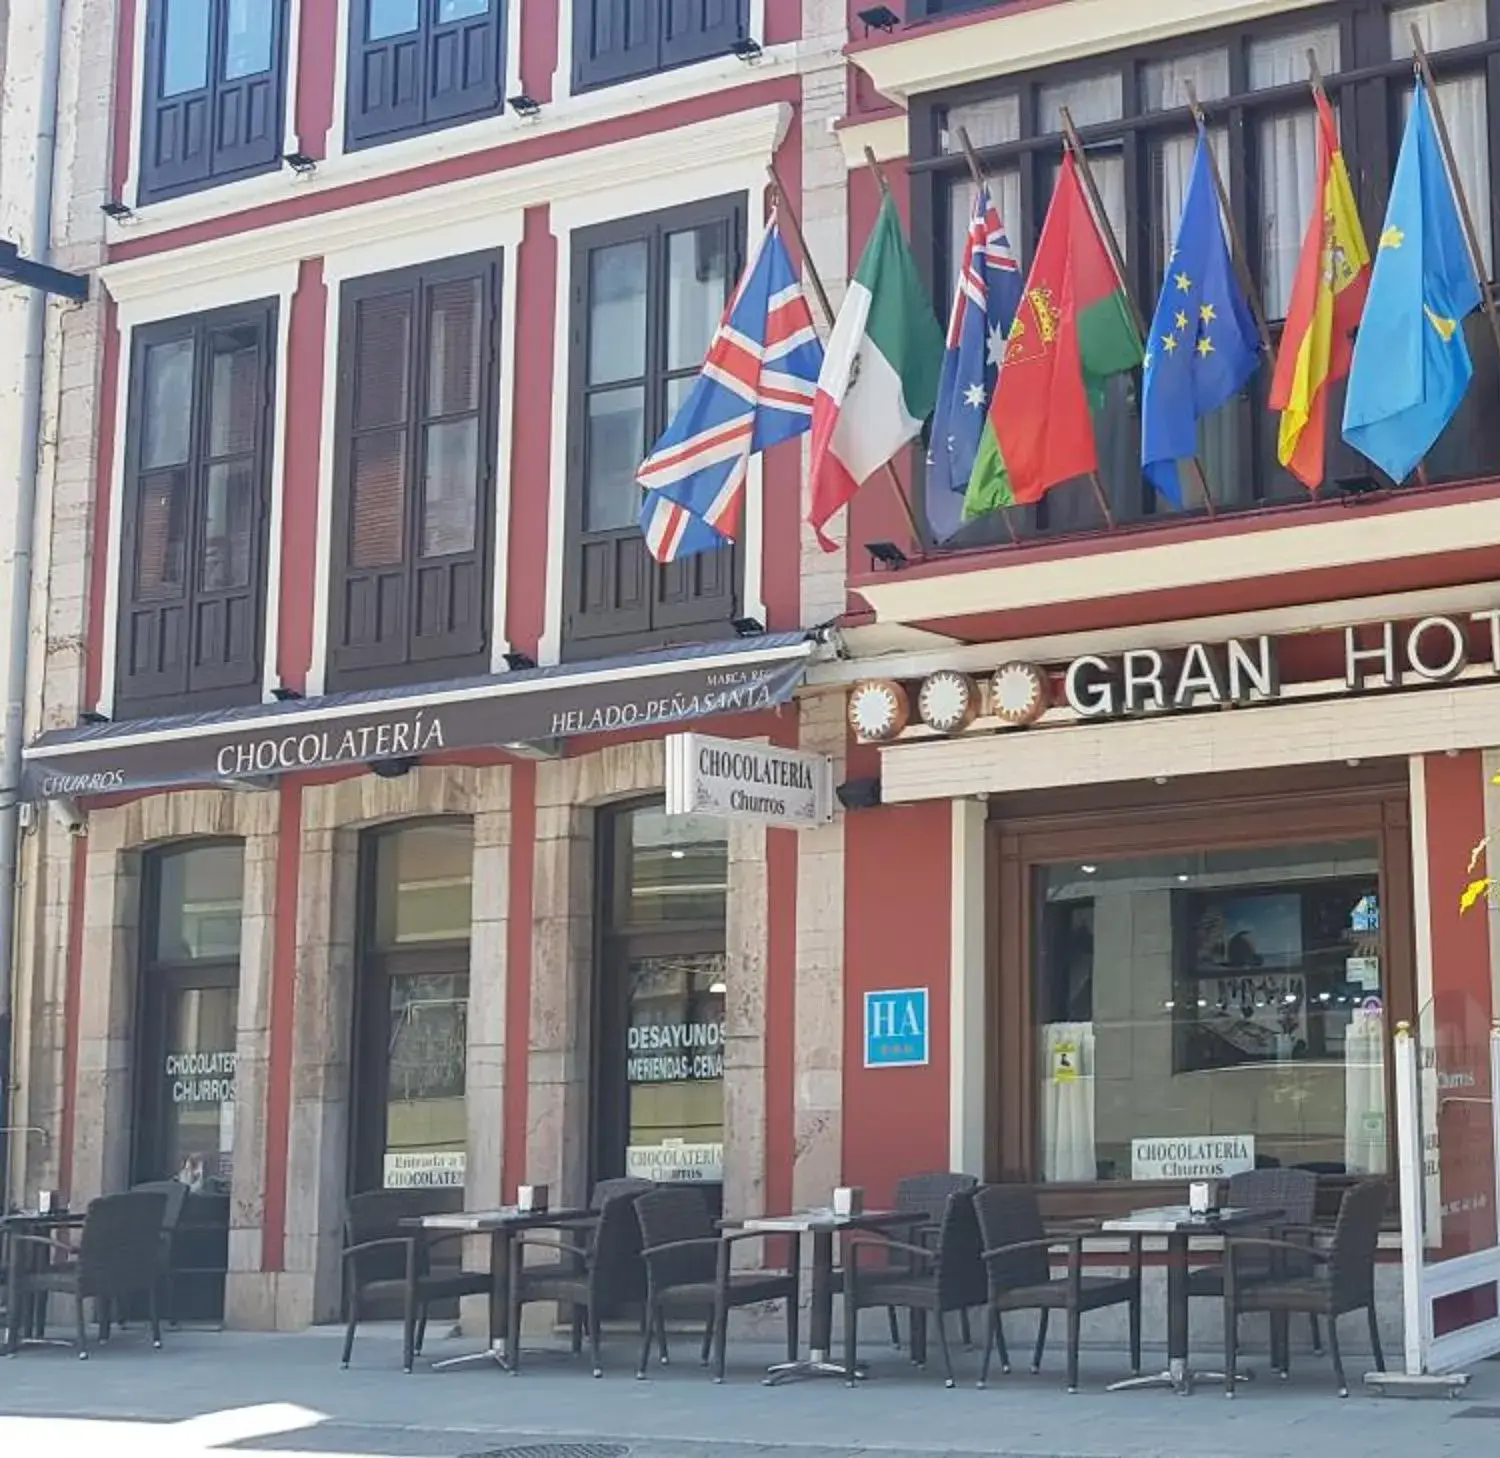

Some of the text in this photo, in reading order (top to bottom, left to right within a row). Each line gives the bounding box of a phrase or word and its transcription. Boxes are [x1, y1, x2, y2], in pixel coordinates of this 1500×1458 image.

[1065, 635, 1277, 718] GRAN
[551, 685, 769, 733] HELADO-PEÑASANTA
[216, 710, 445, 776] CHOCOLATERÍA
[42, 768, 125, 796] CHURROS
[699, 748, 813, 790] CHOCOLATERÍA
[730, 789, 785, 816] Churros
[869, 997, 924, 1038] HA
[627, 1022, 727, 1049] DESAYUNOS
[1137, 1139, 1248, 1162] CHOCOLATERÍA
[1161, 1161, 1224, 1178] Churros
